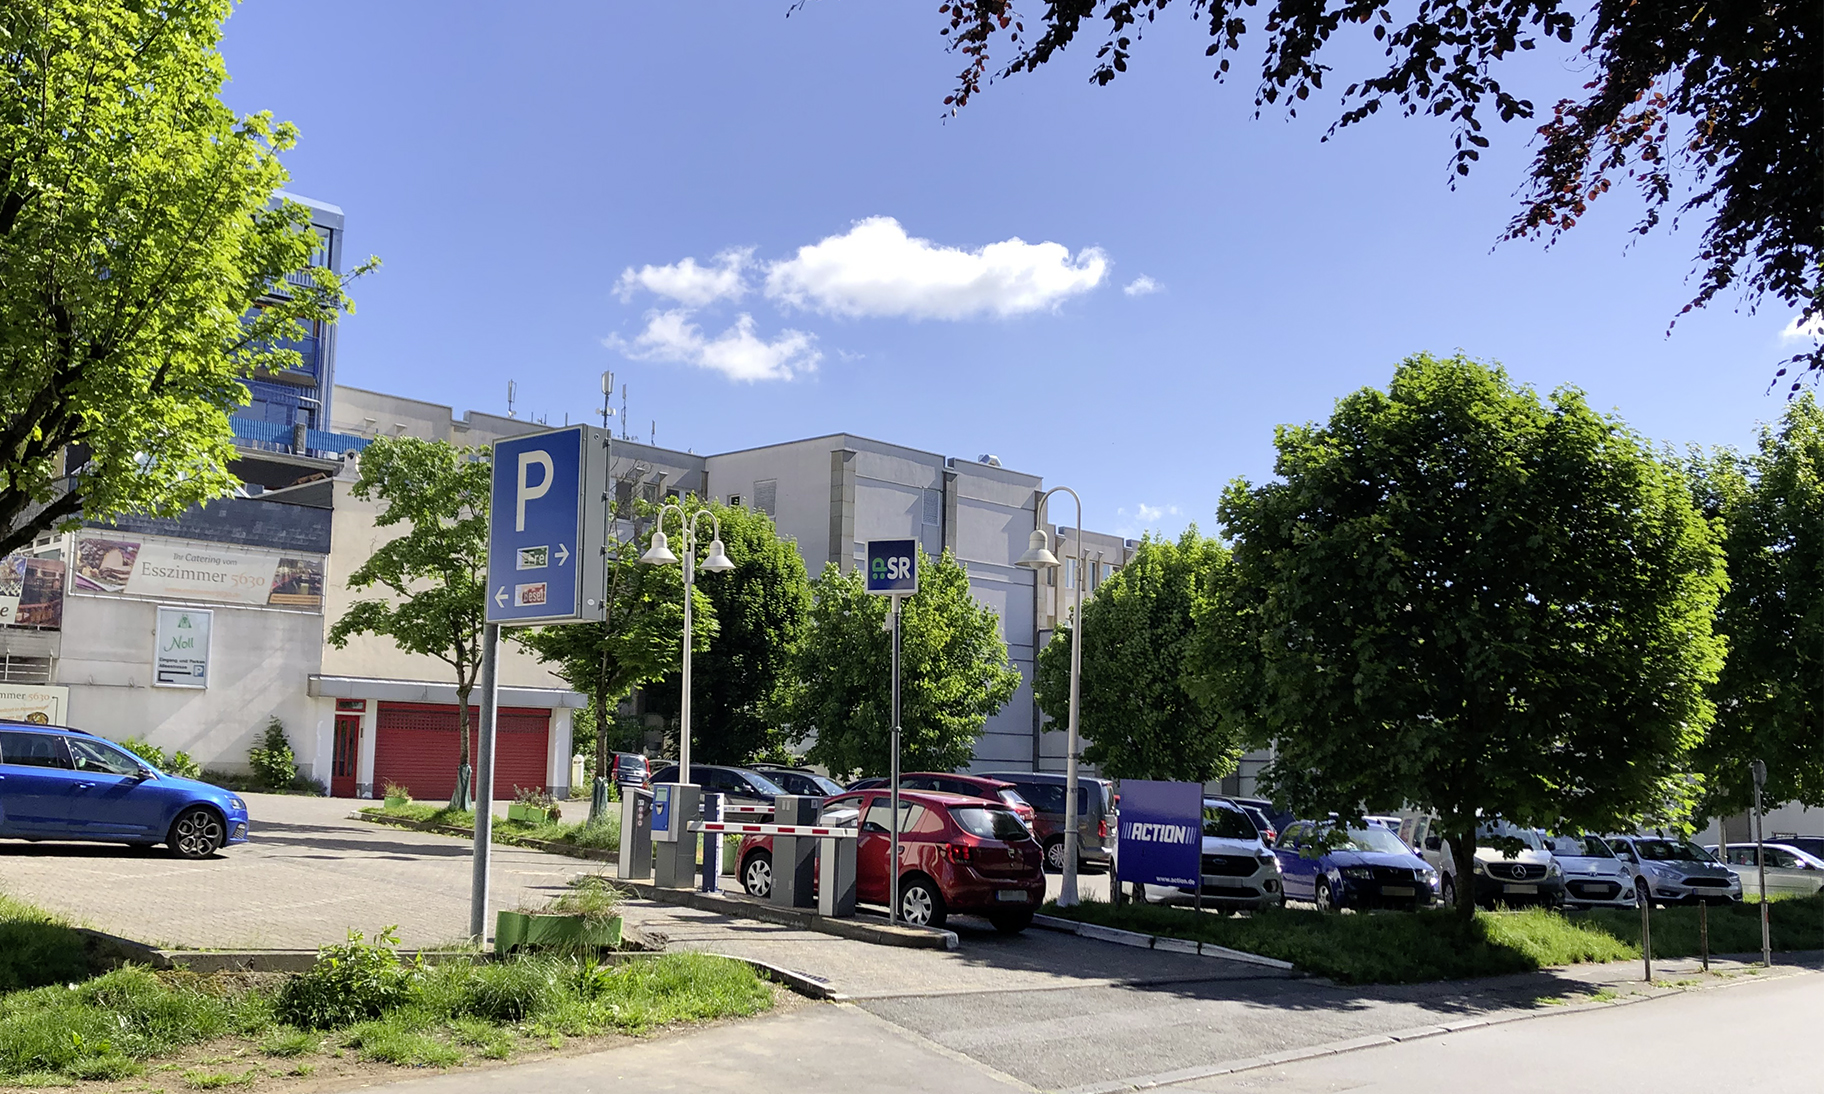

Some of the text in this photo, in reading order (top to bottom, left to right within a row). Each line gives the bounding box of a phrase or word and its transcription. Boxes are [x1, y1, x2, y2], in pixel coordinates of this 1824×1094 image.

[515, 450, 554, 532] P
[173, 553, 238, 566] Ihr Catering vom
[141, 561, 265, 588] Esszimmer 5630
[163, 635, 194, 652] Noll
[28, 691, 50, 701] 5630
[1131, 822, 1186, 844] ACTION
[1156, 876, 1195, 885] www.action.de
